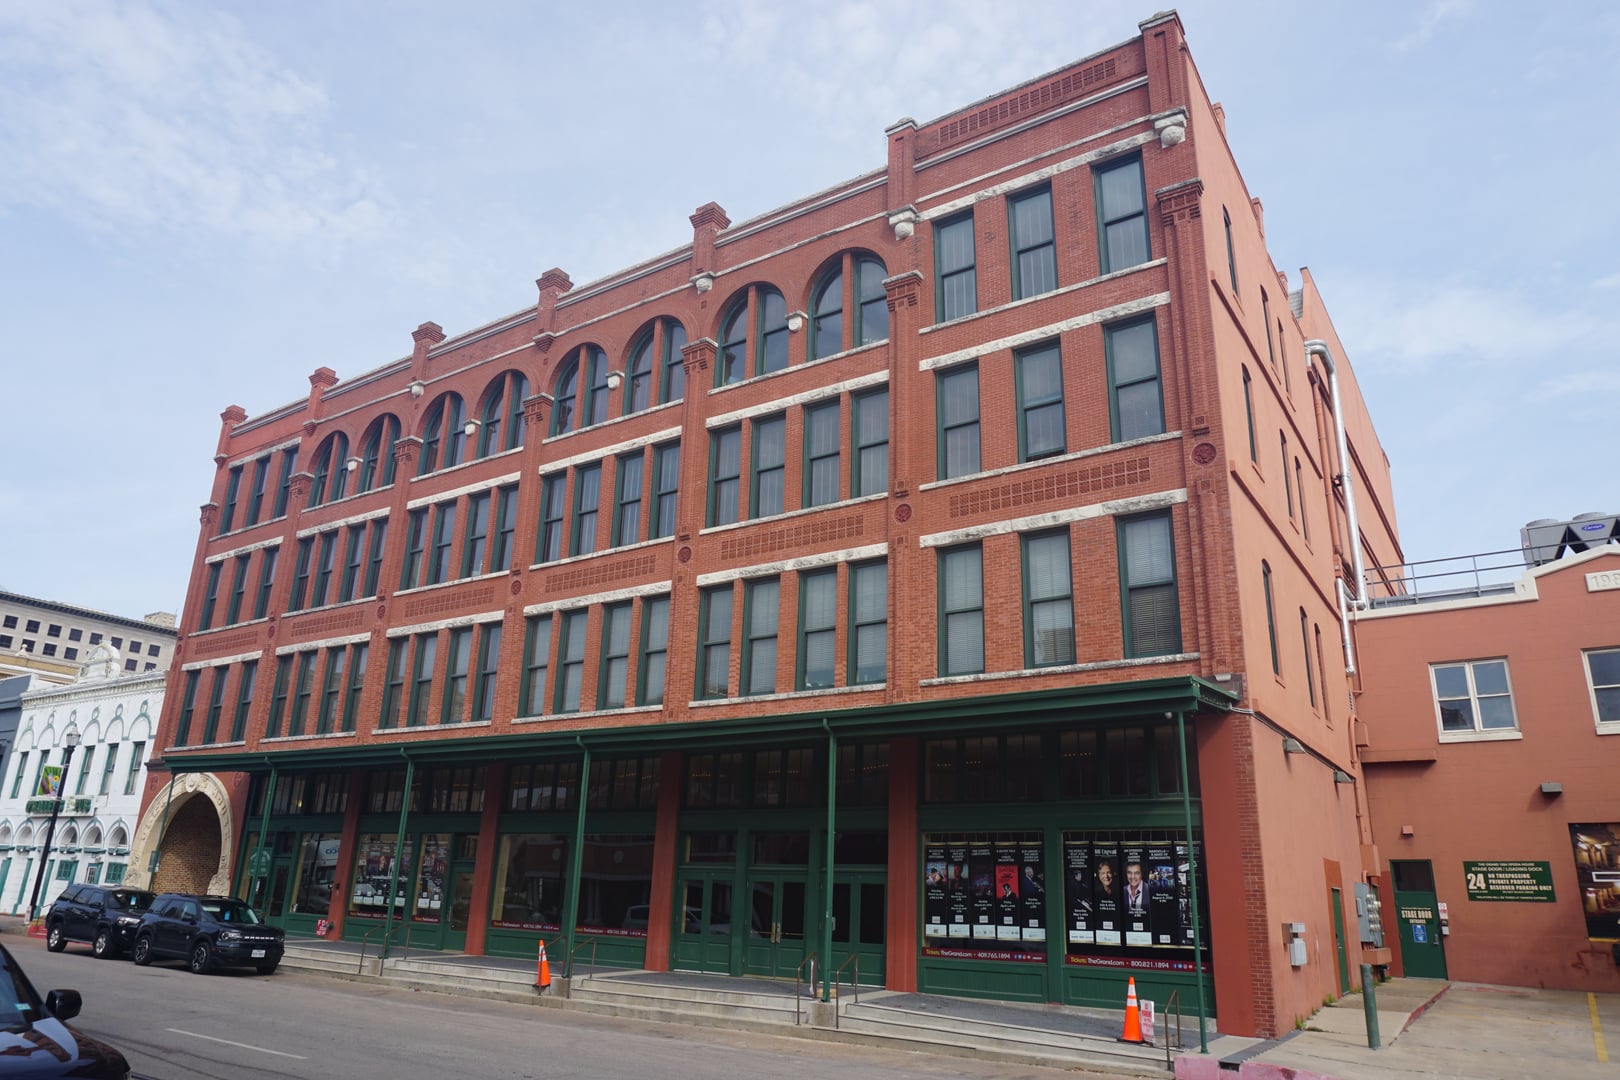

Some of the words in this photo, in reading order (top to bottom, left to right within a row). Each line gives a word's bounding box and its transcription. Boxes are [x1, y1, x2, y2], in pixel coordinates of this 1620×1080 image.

[1467, 873, 1486, 890] 24
[1401, 910, 1417, 918] STAGE
[941, 949, 972, 957] TheGrand.com
[1088, 958, 1124, 966] TheGrand.com
[1131, 960, 1169, 968] 800.821.1894
